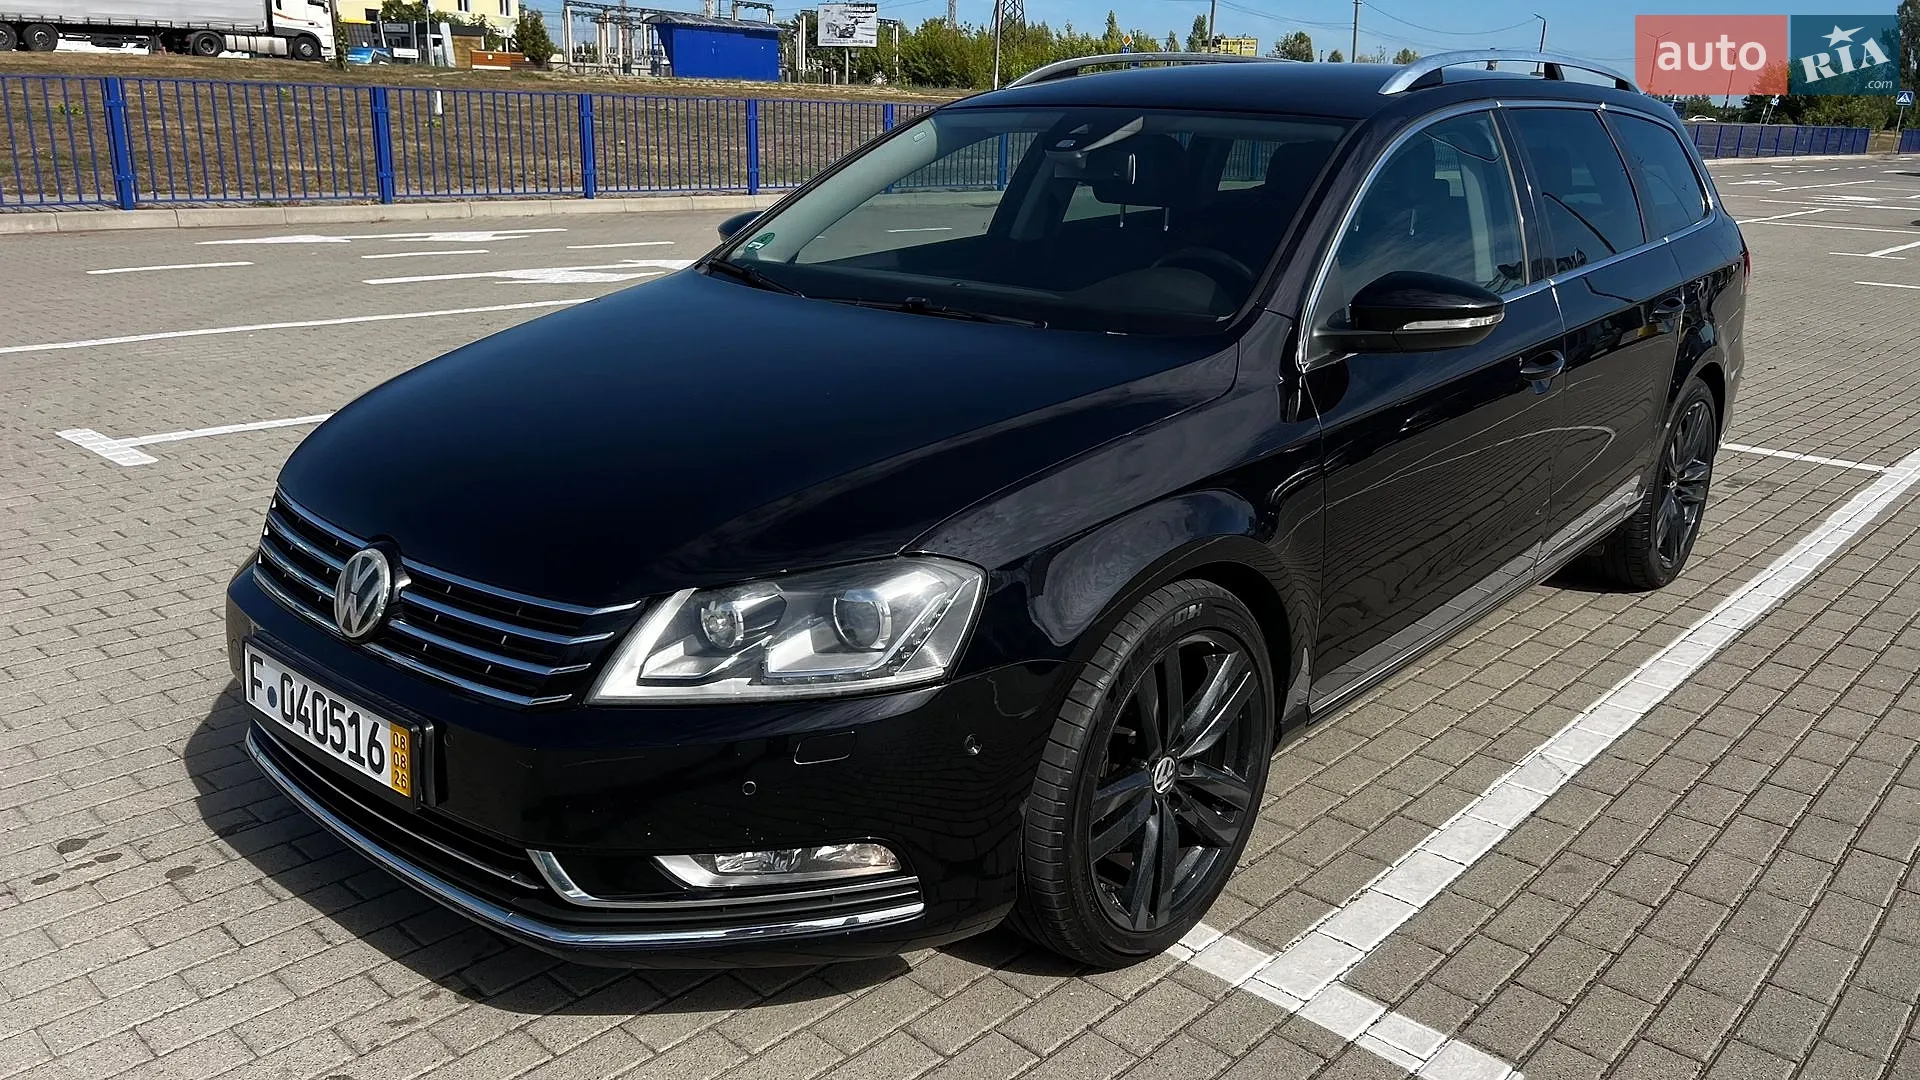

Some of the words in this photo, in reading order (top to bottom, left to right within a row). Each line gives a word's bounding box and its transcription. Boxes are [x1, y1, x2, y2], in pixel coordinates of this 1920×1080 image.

[334, 549, 391, 637] VW
[250, 653, 265, 701] F
[280, 672, 385, 775] 040516
[392, 732, 407, 751] 08
[393, 751, 408, 770] 08
[394, 769, 408, 789] 26
